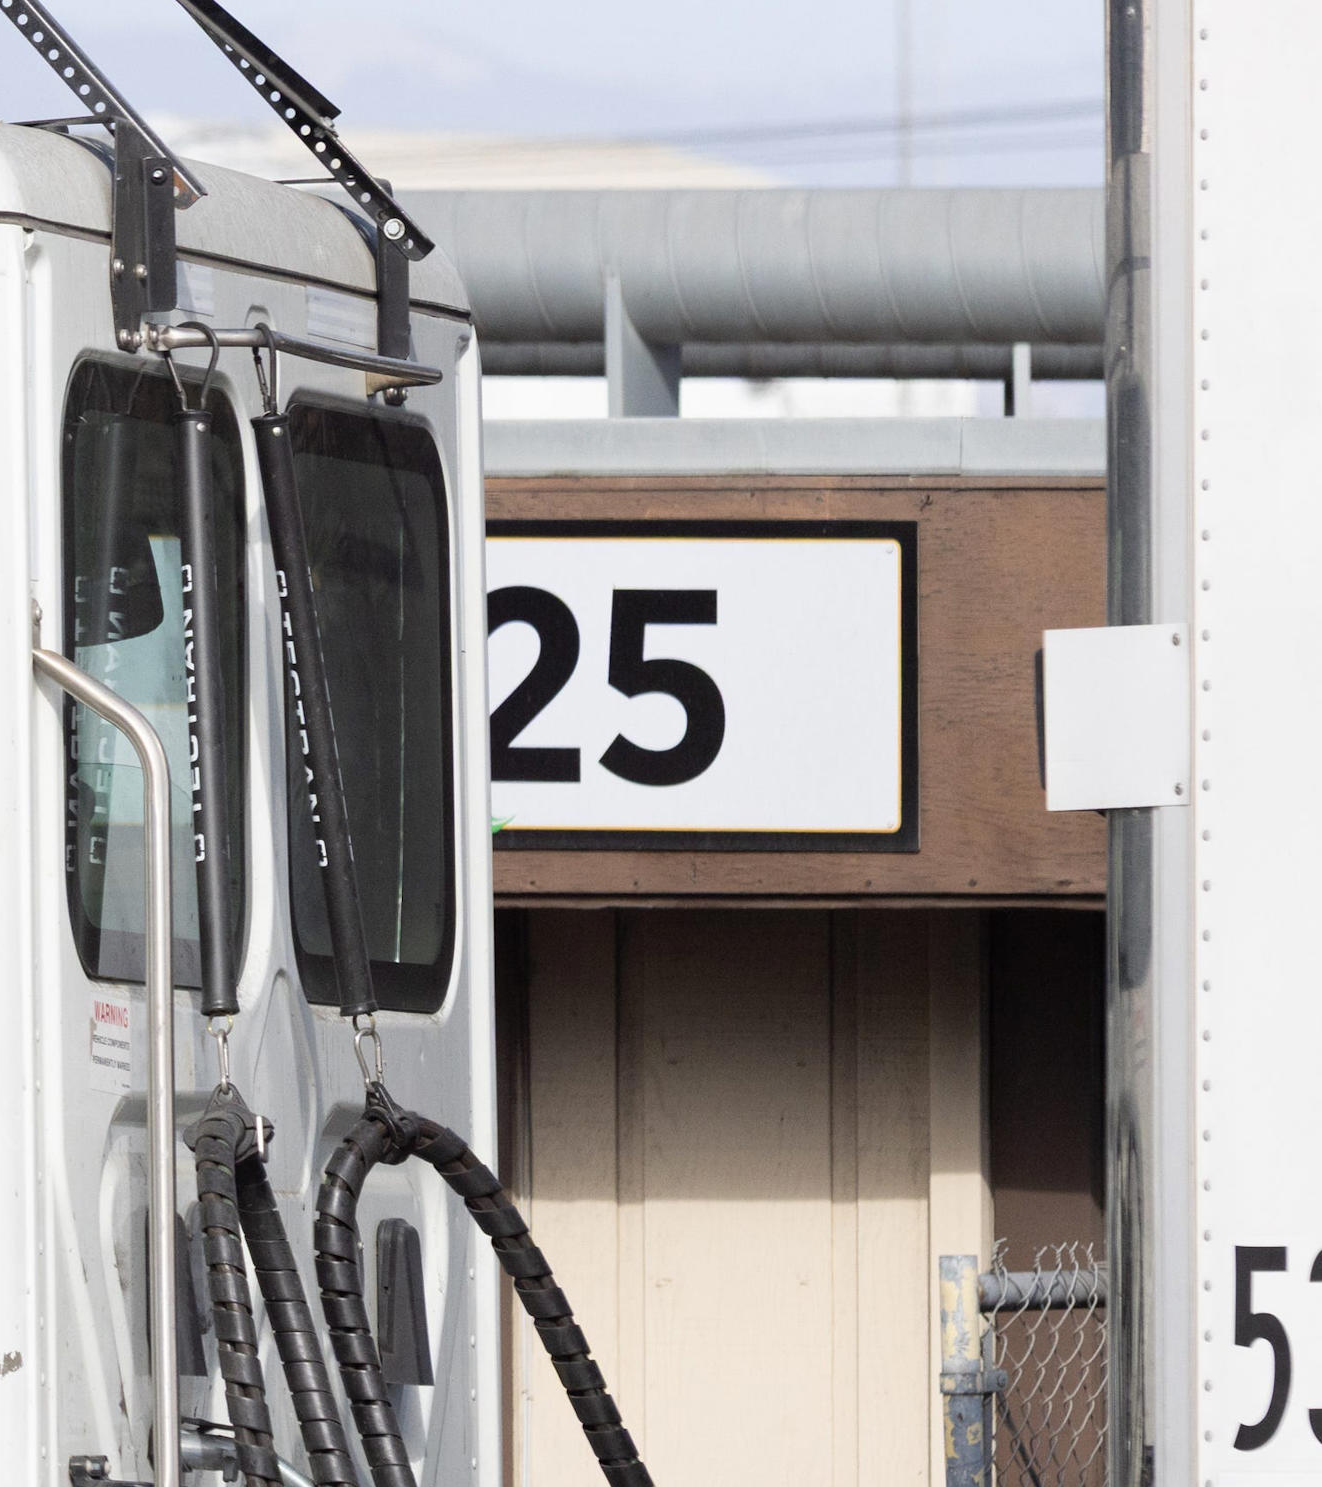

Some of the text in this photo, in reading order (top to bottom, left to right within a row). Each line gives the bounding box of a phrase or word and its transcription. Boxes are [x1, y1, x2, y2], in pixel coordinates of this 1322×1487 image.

[487, 585, 726, 787] 25
[94, 1000, 129, 1029] WARNING
[1233, 1245, 1322, 1451] 5
